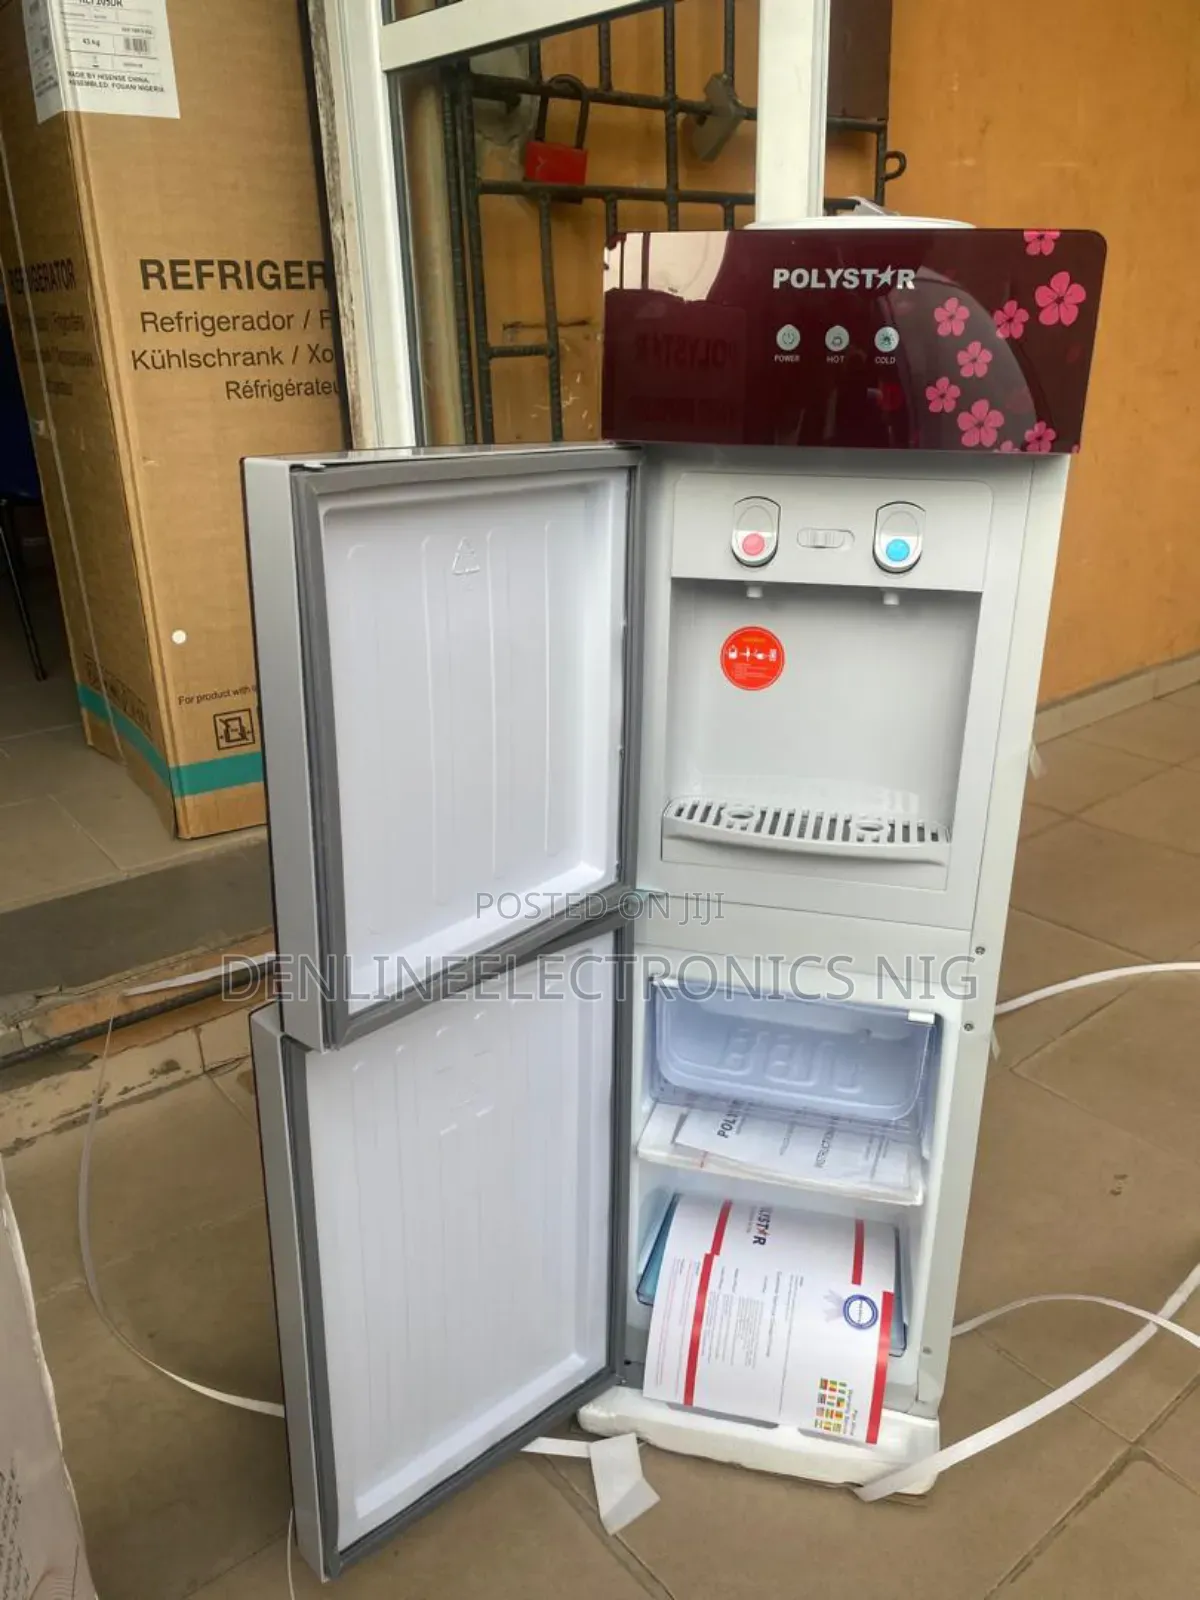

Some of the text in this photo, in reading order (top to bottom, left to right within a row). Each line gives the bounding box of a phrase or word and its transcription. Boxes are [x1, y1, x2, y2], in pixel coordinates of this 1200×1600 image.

[140, 310, 295, 337] Refrigerador
[131, 346, 284, 371] Kühlschrank
[774, 354, 896, 365] POWER HOT COLD
[177, 696, 194, 705] For
[196, 689, 230, 704] product
